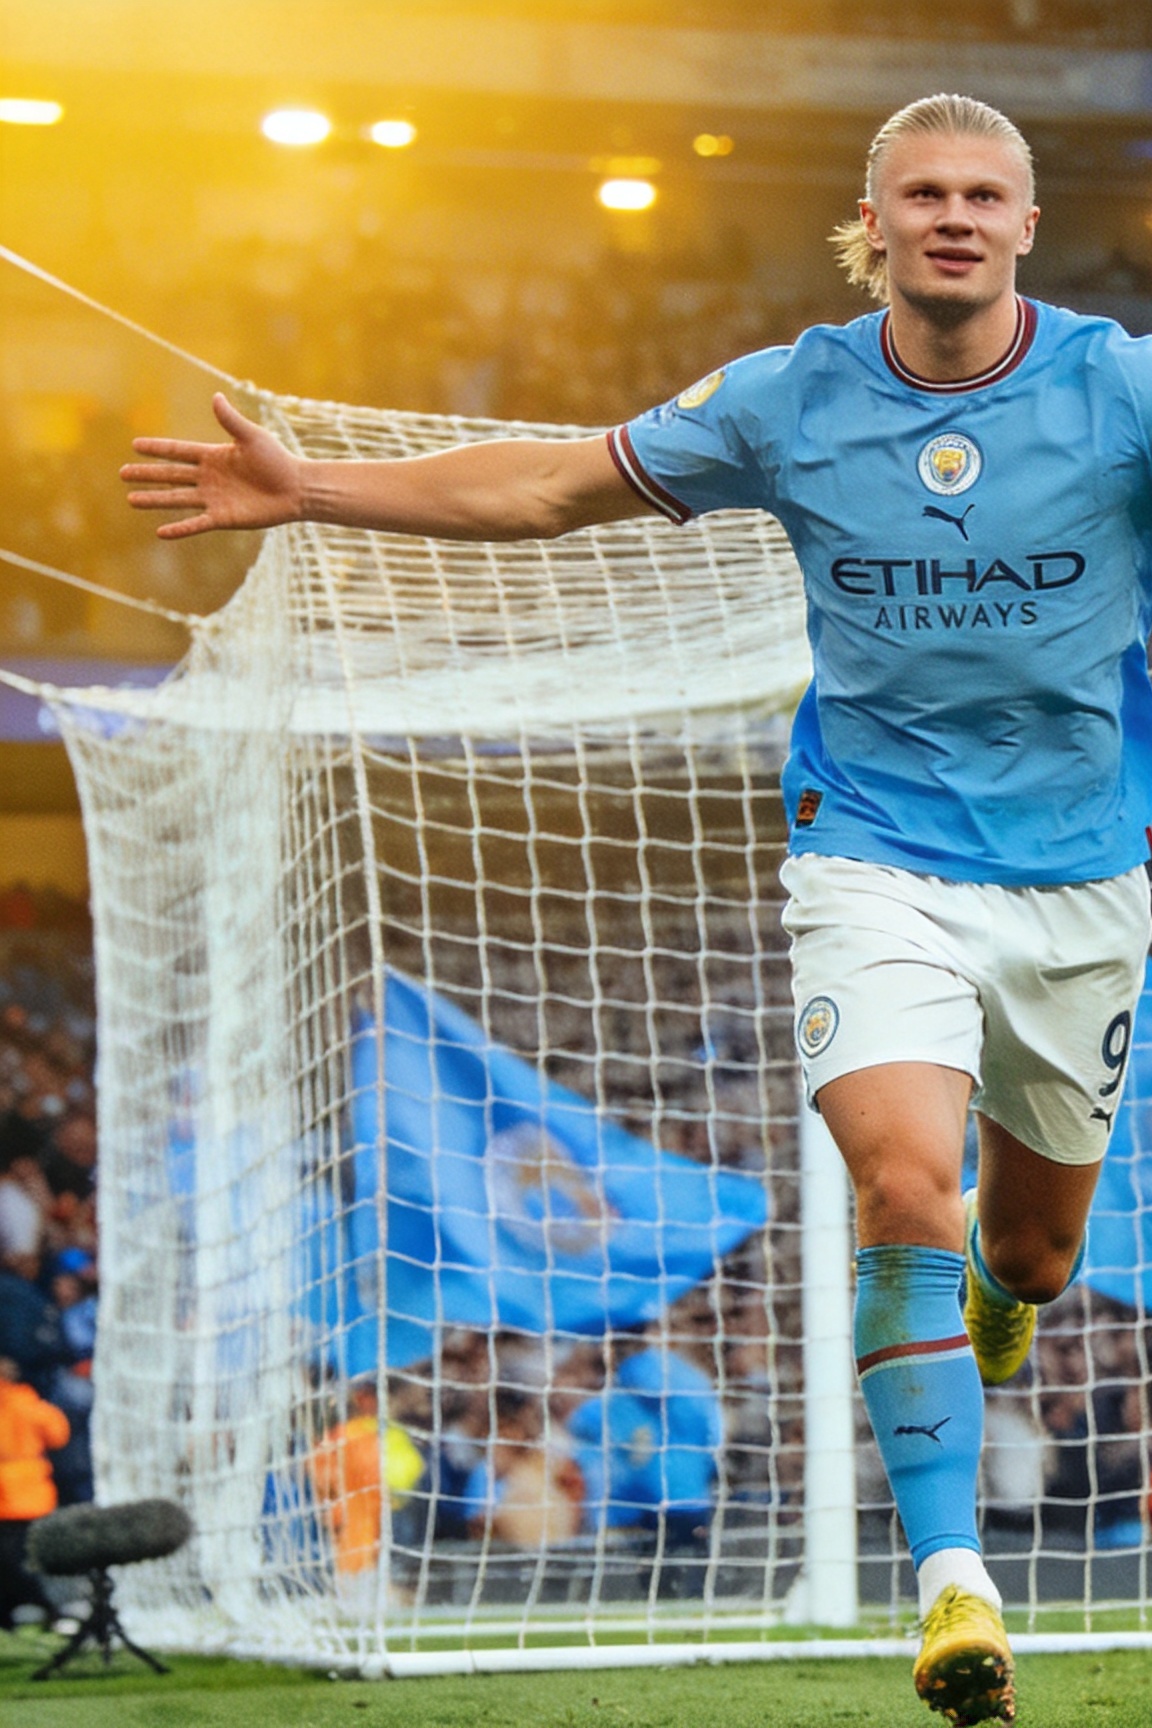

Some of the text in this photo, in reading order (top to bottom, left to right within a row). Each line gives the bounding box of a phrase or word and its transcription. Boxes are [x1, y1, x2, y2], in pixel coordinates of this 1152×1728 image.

[830, 551, 1086, 596] ETIHAD
[874, 601, 1038, 630] AIRWAYS
[1098, 1009, 1131, 1097] 9
